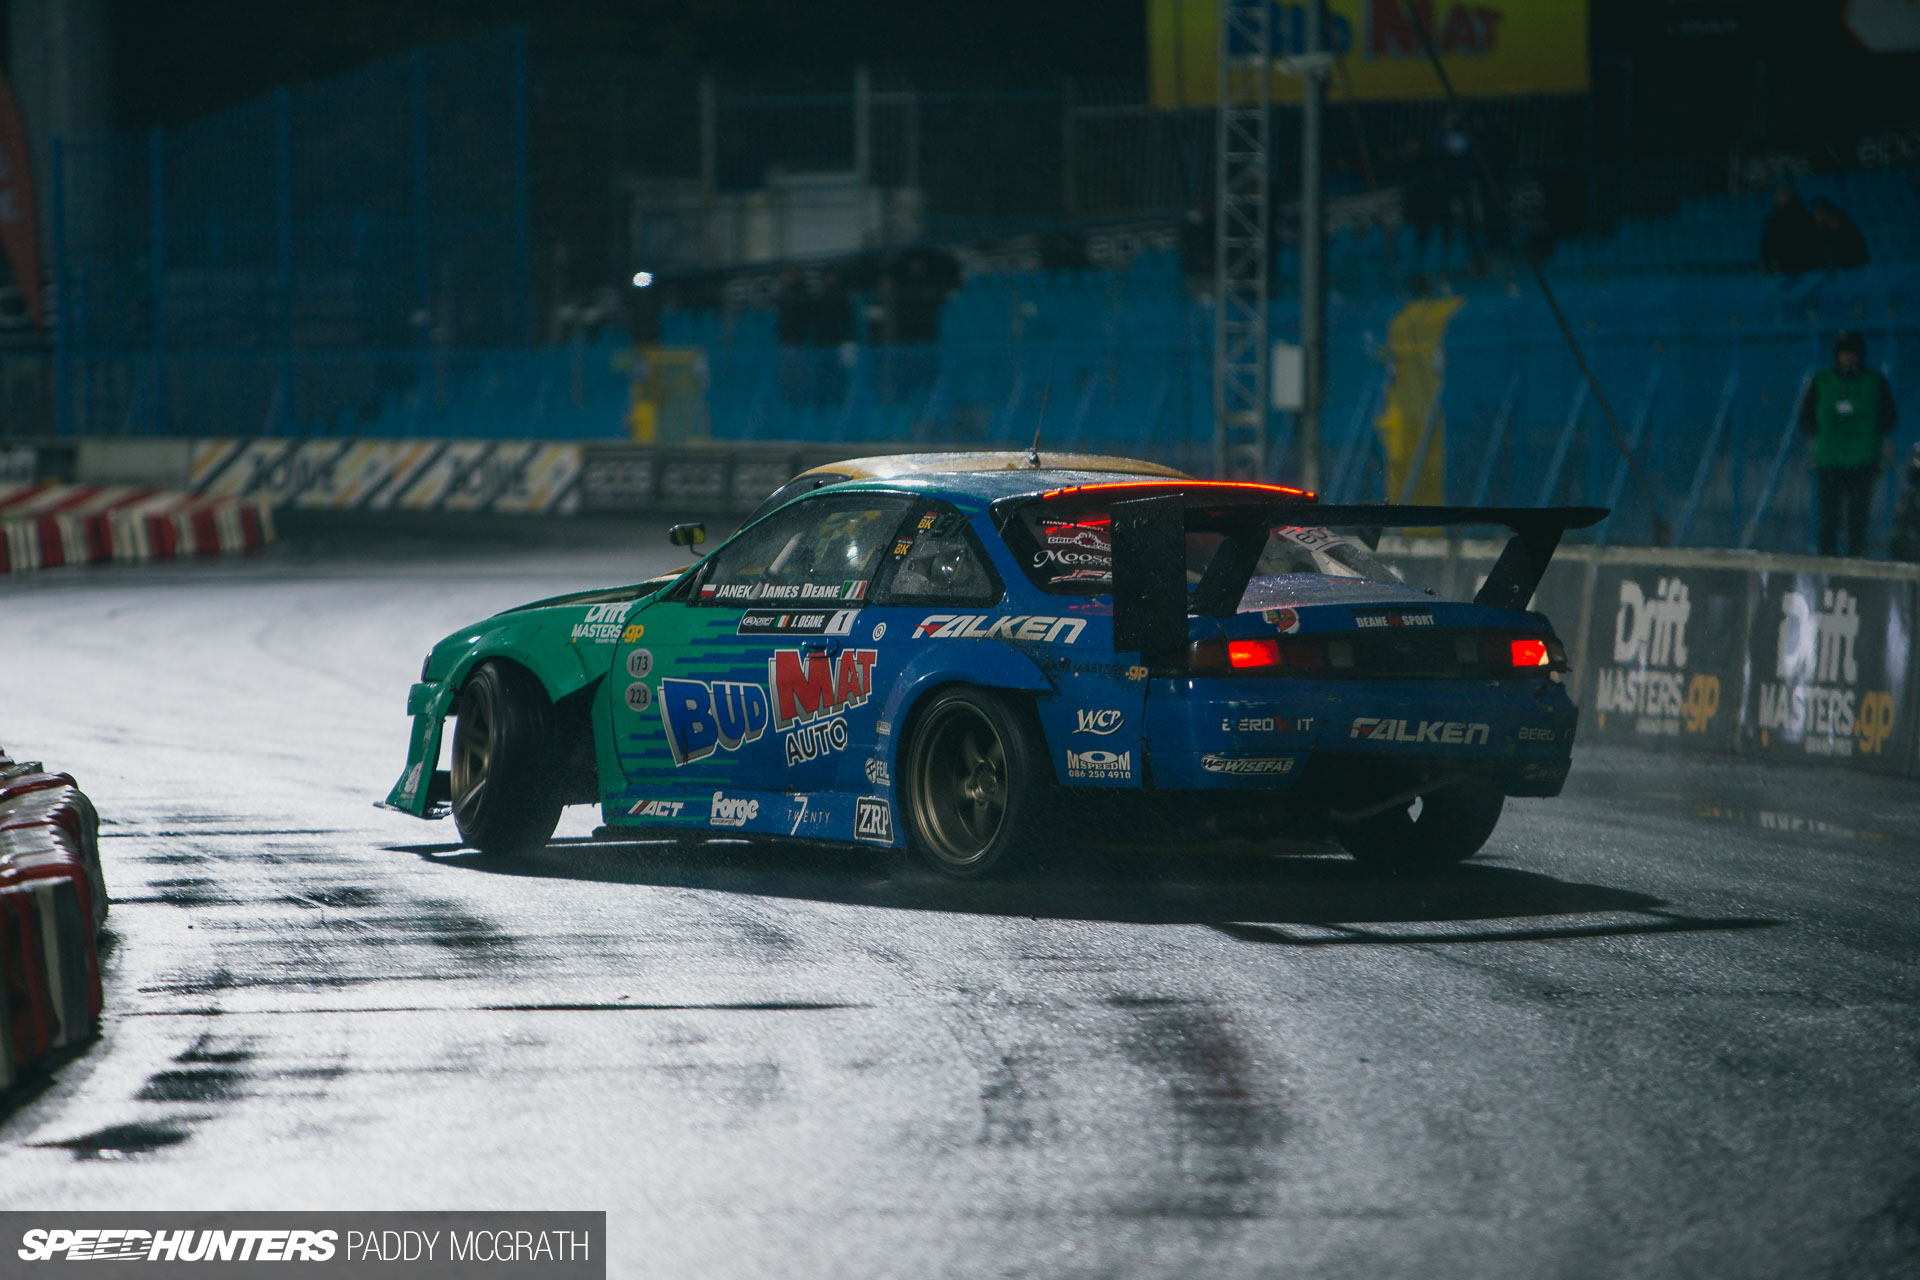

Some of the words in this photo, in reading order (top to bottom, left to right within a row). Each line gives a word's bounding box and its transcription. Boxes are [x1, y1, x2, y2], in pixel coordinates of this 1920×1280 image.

[716, 584, 752, 598] JANEK
[760, 582, 799, 598] JAMES
[801, 583, 840, 598] DEANE
[837, 611, 850, 631] 1
[912, 614, 1088, 644] FALKEN
[631, 655, 648, 672] 173
[630, 688, 647, 705] 223
[657, 677, 769, 768] BUD
[768, 648, 878, 733] MAT
[785, 716, 848, 767] AUTO
[1349, 717, 1490, 745] FALKEN
[1068, 769, 1086, 778] 086
[1088, 769, 1106, 779] 250
[1107, 770, 1132, 779] 4910
[858, 803, 889, 835] ZRP
